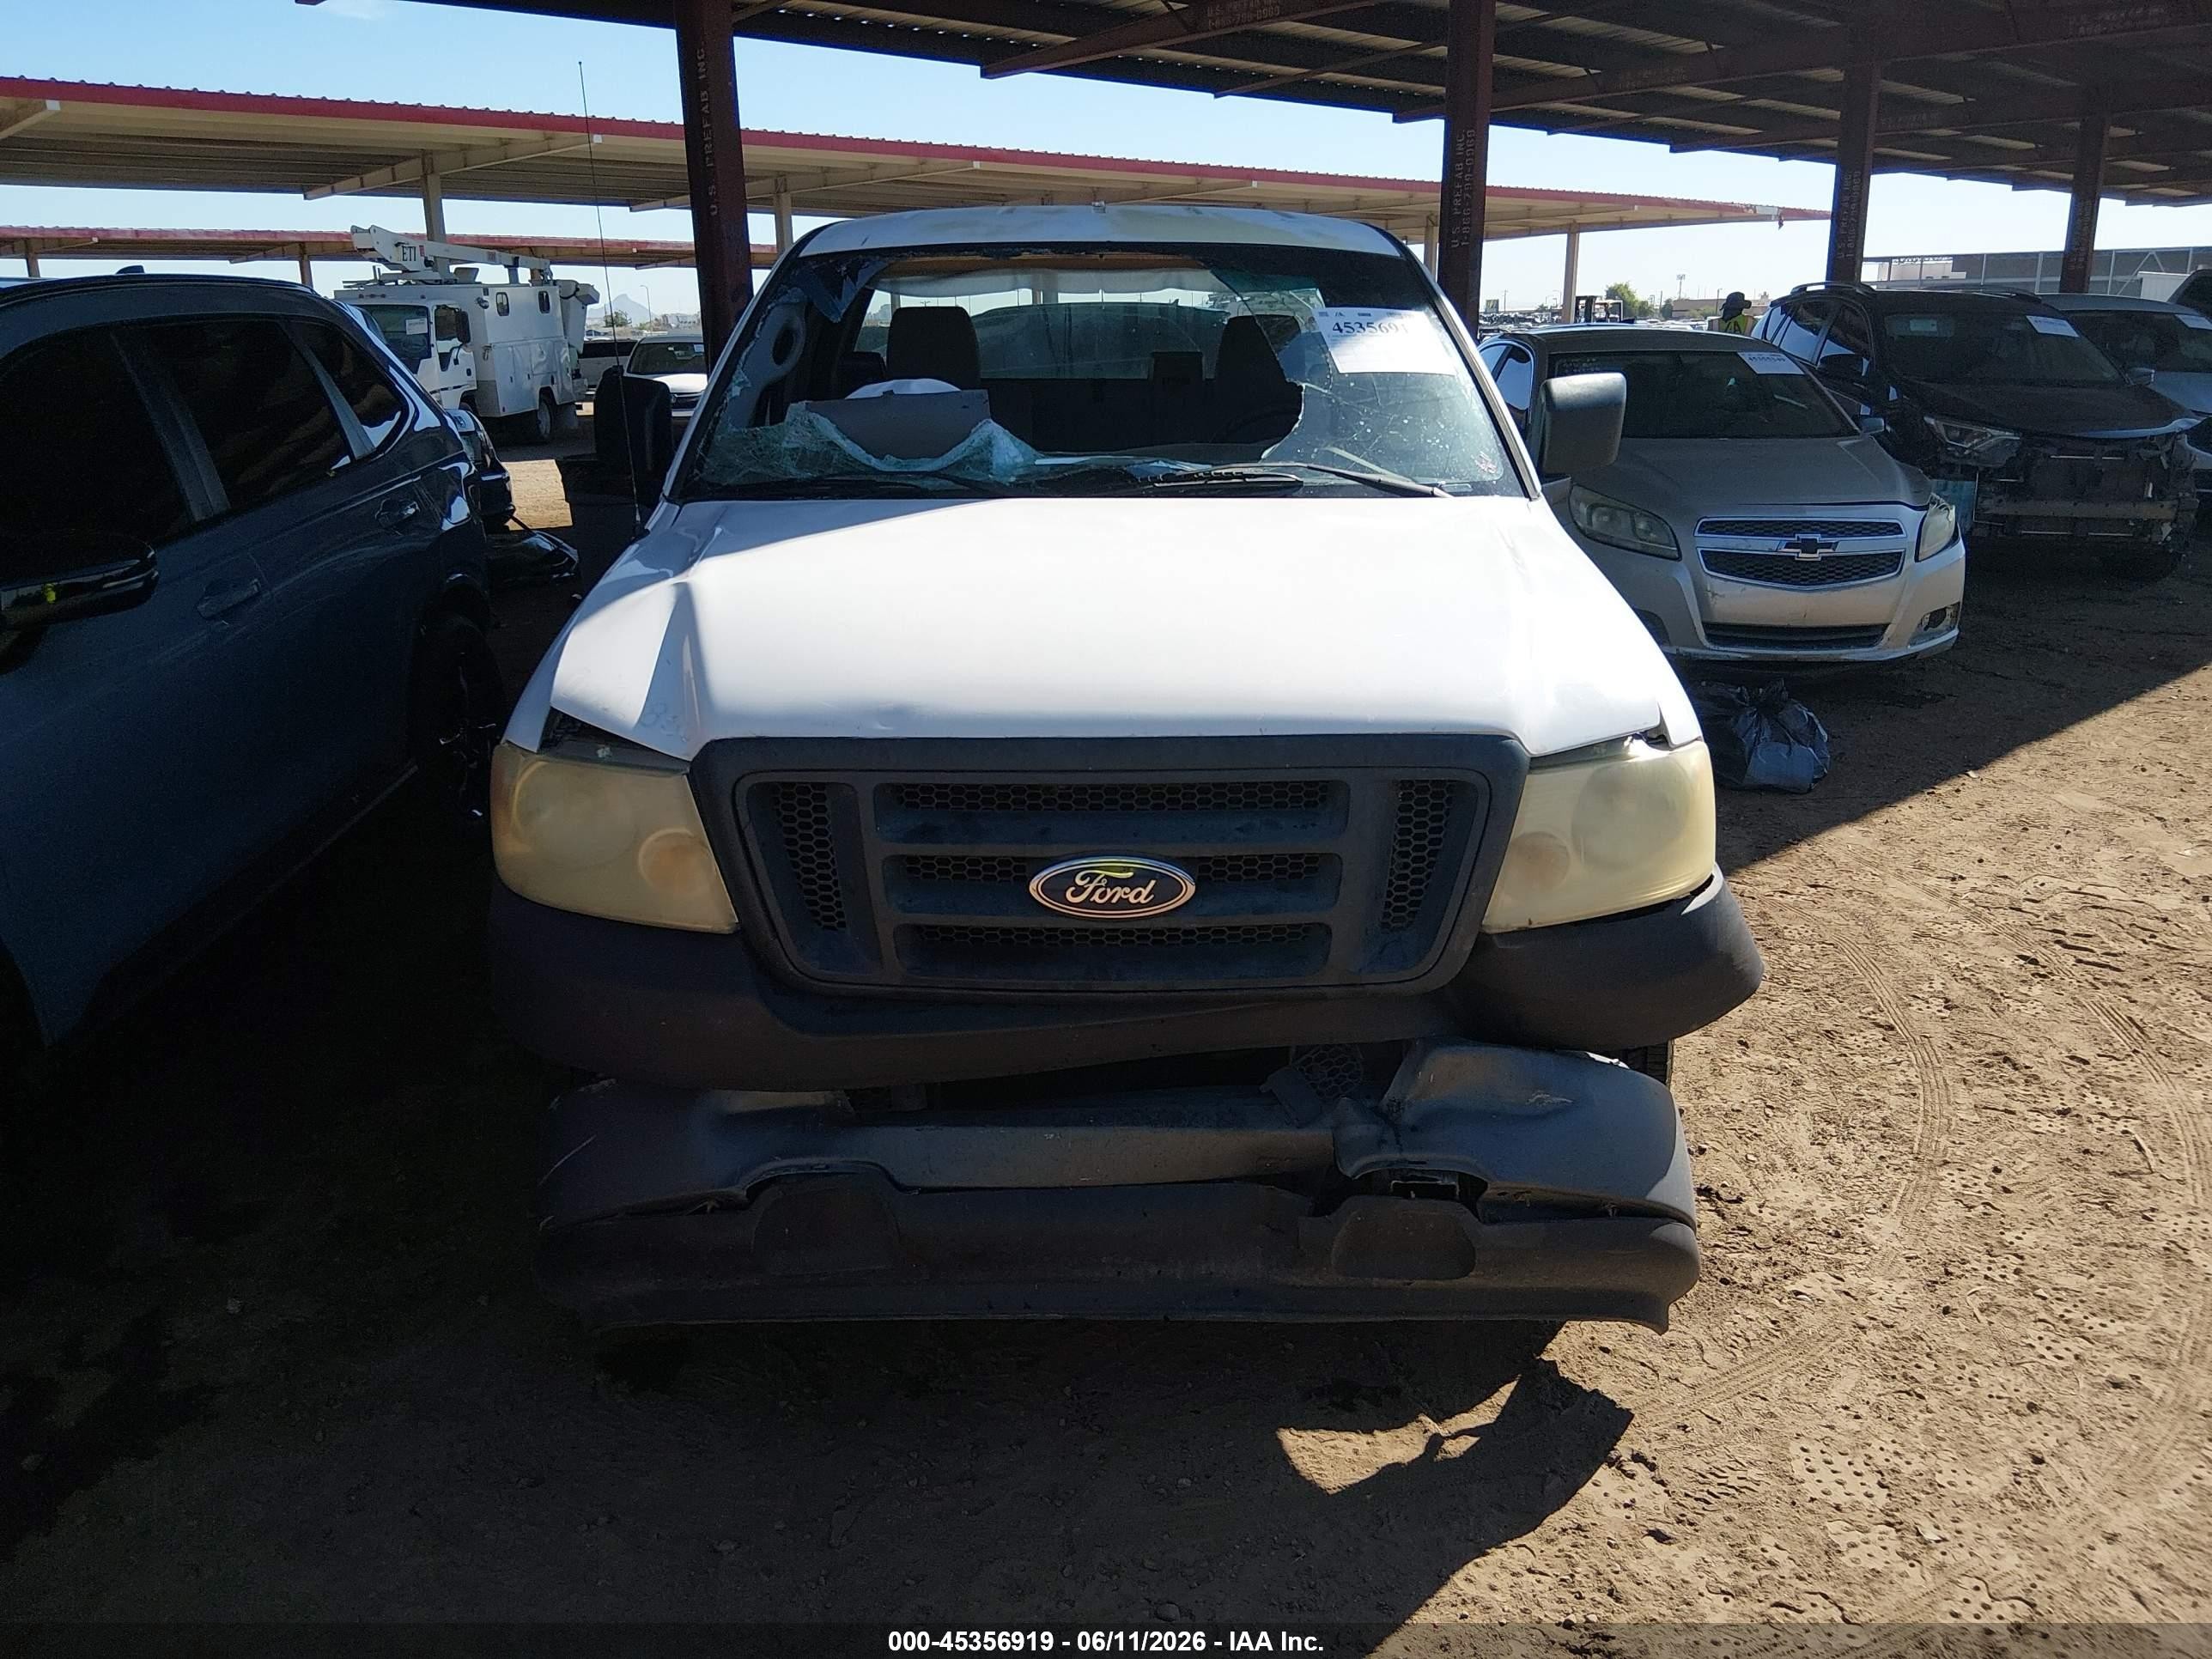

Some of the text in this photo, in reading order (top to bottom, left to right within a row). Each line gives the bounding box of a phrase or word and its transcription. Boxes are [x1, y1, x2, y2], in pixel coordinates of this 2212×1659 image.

[701, 90, 714, 167] PREFAB
[1453, 163, 1463, 215] PREFAB
[402, 246, 416, 262] ETI
[1065, 869, 1157, 904] Ford
